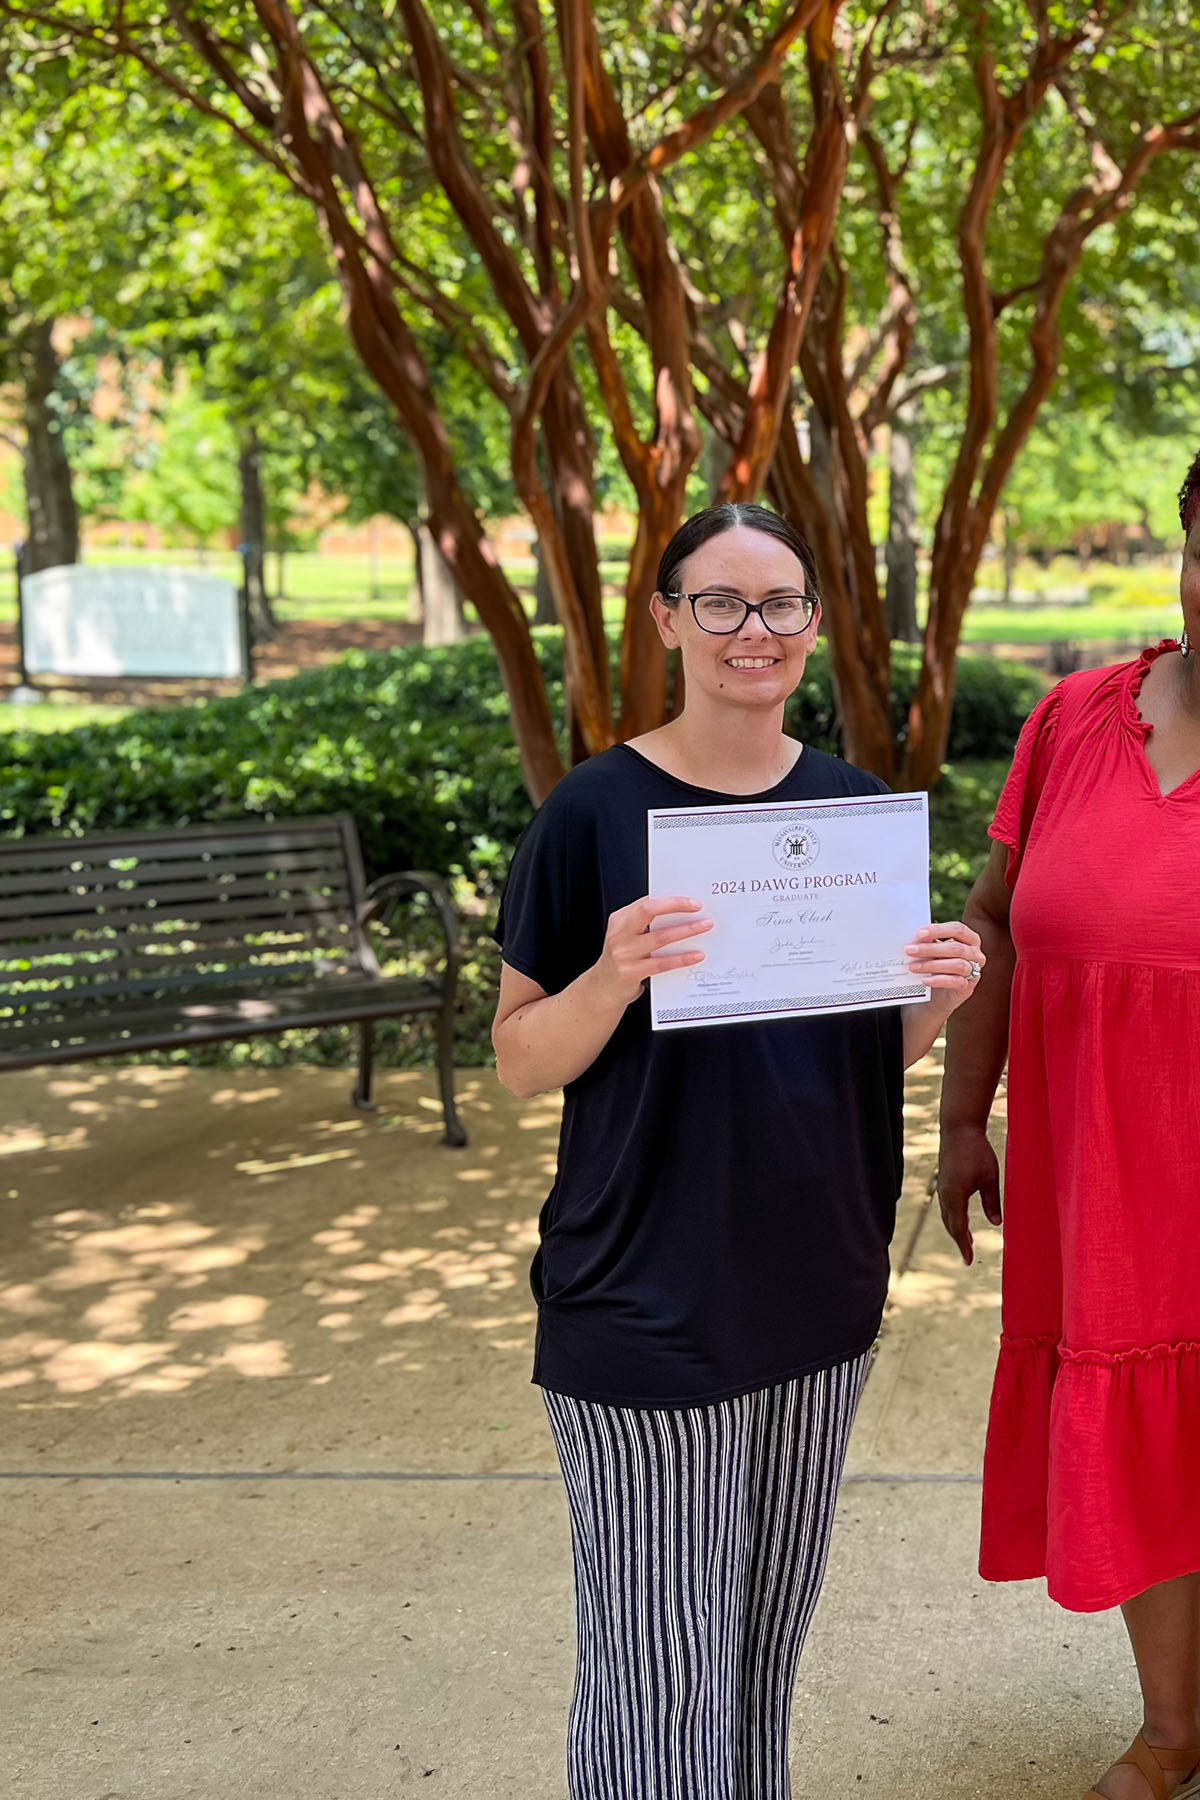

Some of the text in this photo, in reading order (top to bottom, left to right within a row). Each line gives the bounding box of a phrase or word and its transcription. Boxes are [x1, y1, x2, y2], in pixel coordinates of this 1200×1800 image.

[774, 825, 805, 846] MISSISSIPPI
[778, 856, 814, 869] UNIVERSITY
[711, 871, 877, 895] 2024 DAWG PROGRAM
[772, 893, 820, 903] GRADUATE
[756, 909, 834, 927] Tina Clark
